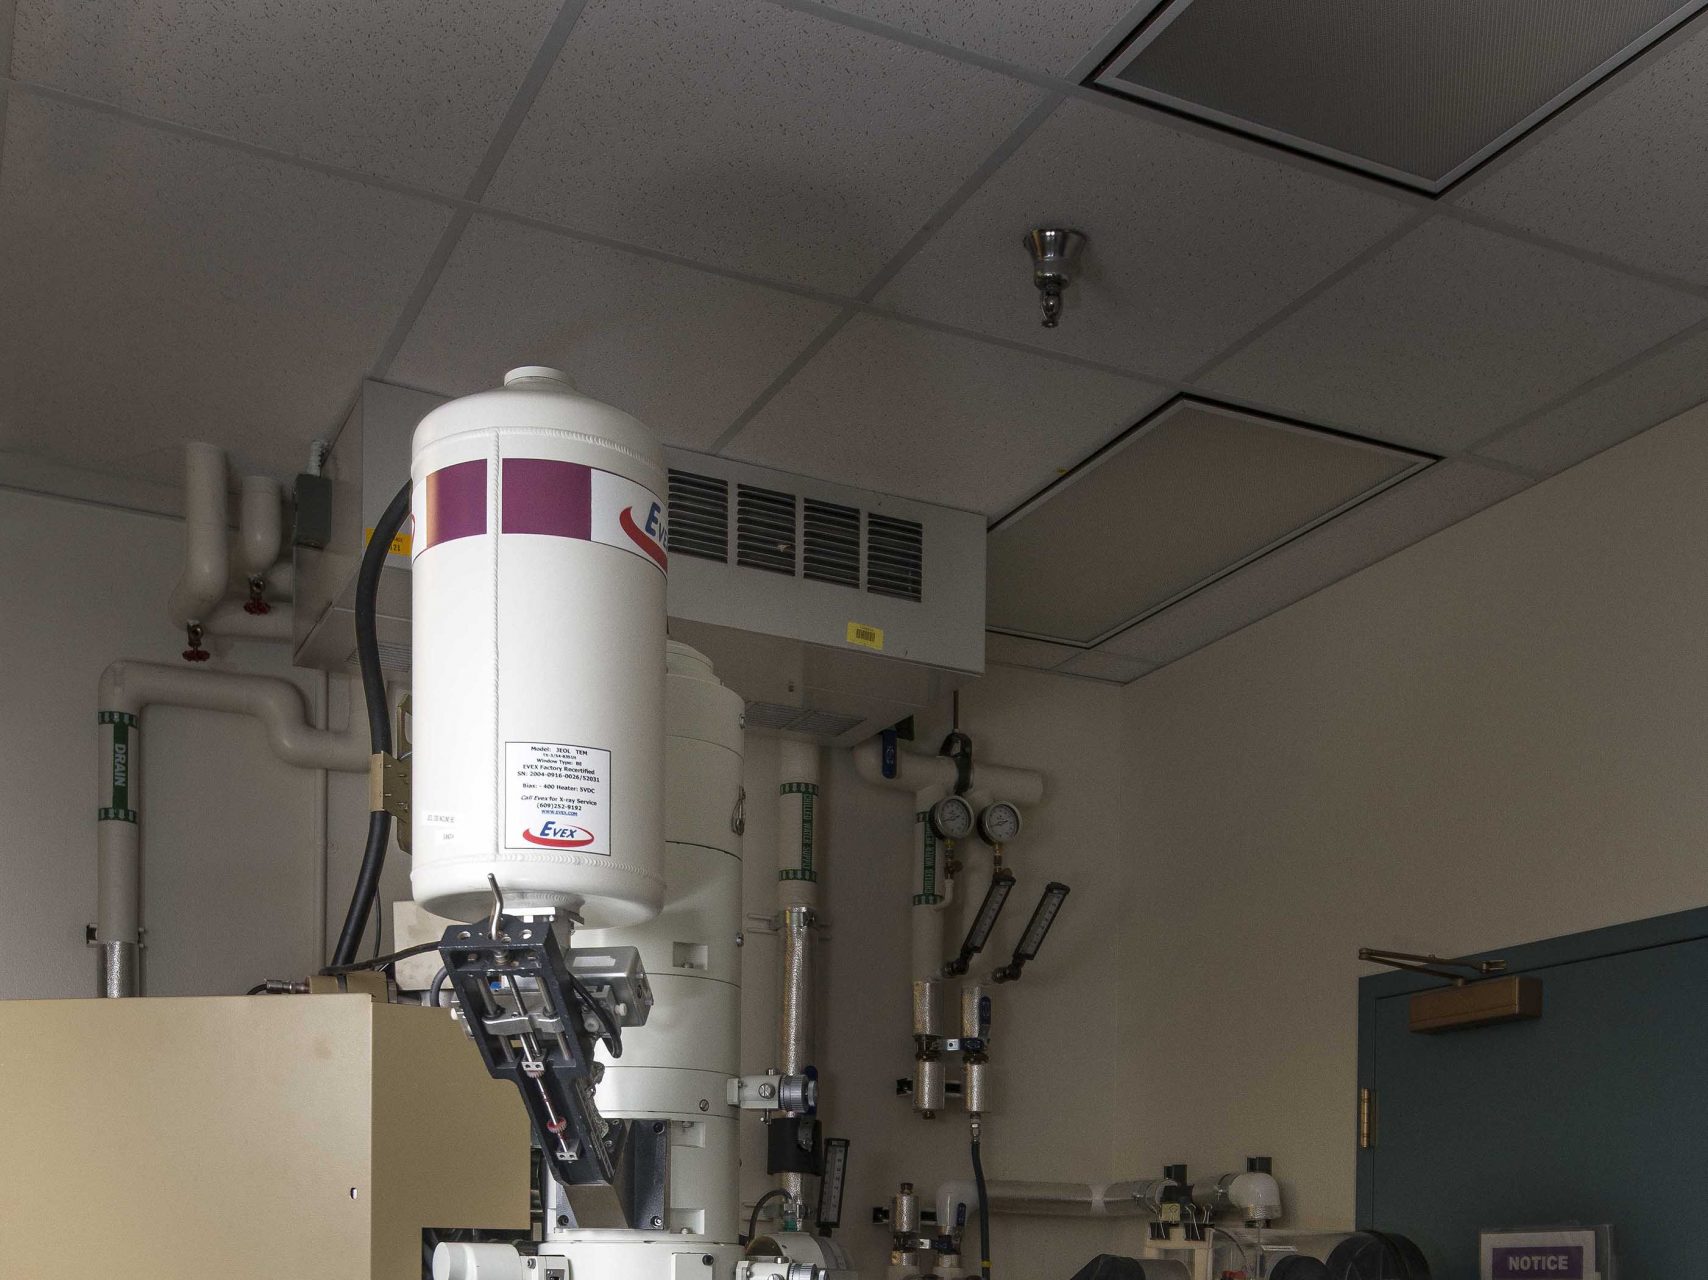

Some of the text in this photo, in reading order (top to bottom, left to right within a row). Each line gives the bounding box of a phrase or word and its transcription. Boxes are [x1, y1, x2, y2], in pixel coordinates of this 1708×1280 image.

[645, 502, 668, 549] EVE
[114, 743, 127, 787] DRAIN
[540, 765, 562, 773] Factory
[563, 766, 595, 775] Recertified
[556, 784, 578, 792] Heater:
[536, 803, 582, 811] (609)252-9192
[559, 796, 575, 805] X-ray
[576, 798, 597, 807] Service
[539, 821, 577, 839] EVEX
[1508, 1255, 1568, 1271] NOTICE
